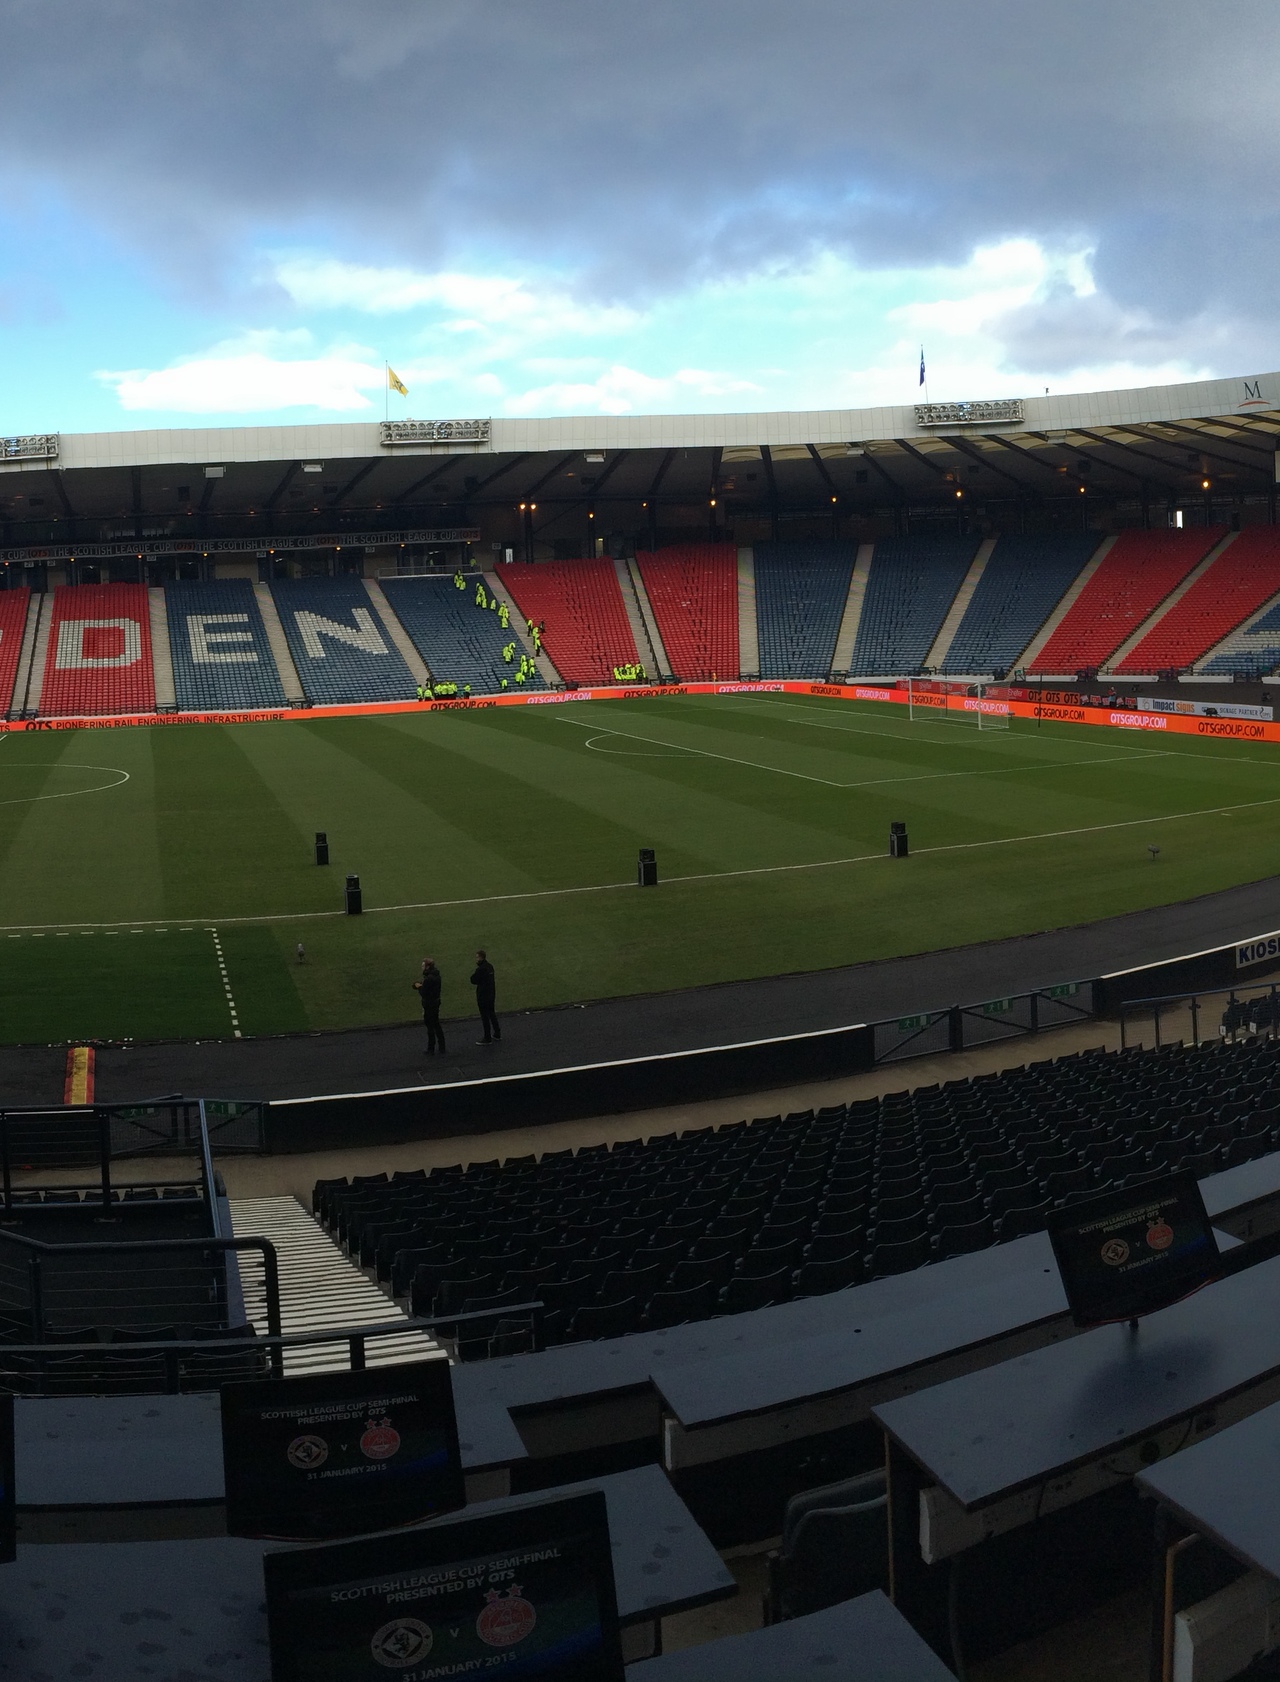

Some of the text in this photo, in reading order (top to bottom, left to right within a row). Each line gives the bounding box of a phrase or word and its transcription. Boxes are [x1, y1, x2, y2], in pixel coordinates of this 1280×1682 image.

[1244, 381, 1263, 401] M
[7, 550, 25, 559] CUP
[53, 548, 70, 557] THE
[72, 545, 113, 556] SCOTTISH
[115, 544, 150, 554] LEAGUE
[153, 542, 171, 551] CUP
[197, 541, 214, 550] THE
[217, 539, 258, 549] SCOTTISH
[260, 539, 294, 548] LEAGUE
[297, 538, 313, 546] CUP
[342, 536, 360, 545] THE
[360, 533, 400, 543] SCOTTISH
[403, 531, 437, 541] LEAGUE
[440, 531, 457, 540] CUP
[1152, 699, 1176, 712] Impact
[1176, 702, 1195, 713] signs
[56, 719, 112, 730] PIONEERING
[114, 718, 135, 728] RAIL
[204, 713, 285, 724] INFRASTRUCTURE
[261, 1394, 420, 1420] SCOTTISH LEAGUE CUP SEMI-FINAL
[297, 1412, 352, 1425] PRESENTED
[352, 1411, 364, 1420] BY
[307, 1463, 388, 1481] 31 JANUARY 2015
[330, 1548, 562, 1603] SCOTTISH LEAGUE CUP SEMI-FINAL
[386, 1582, 464, 1604] PRESENTED
[467, 1577, 484, 1590] BY
[402, 1651, 518, 1682] 31 JANUARY 2015
